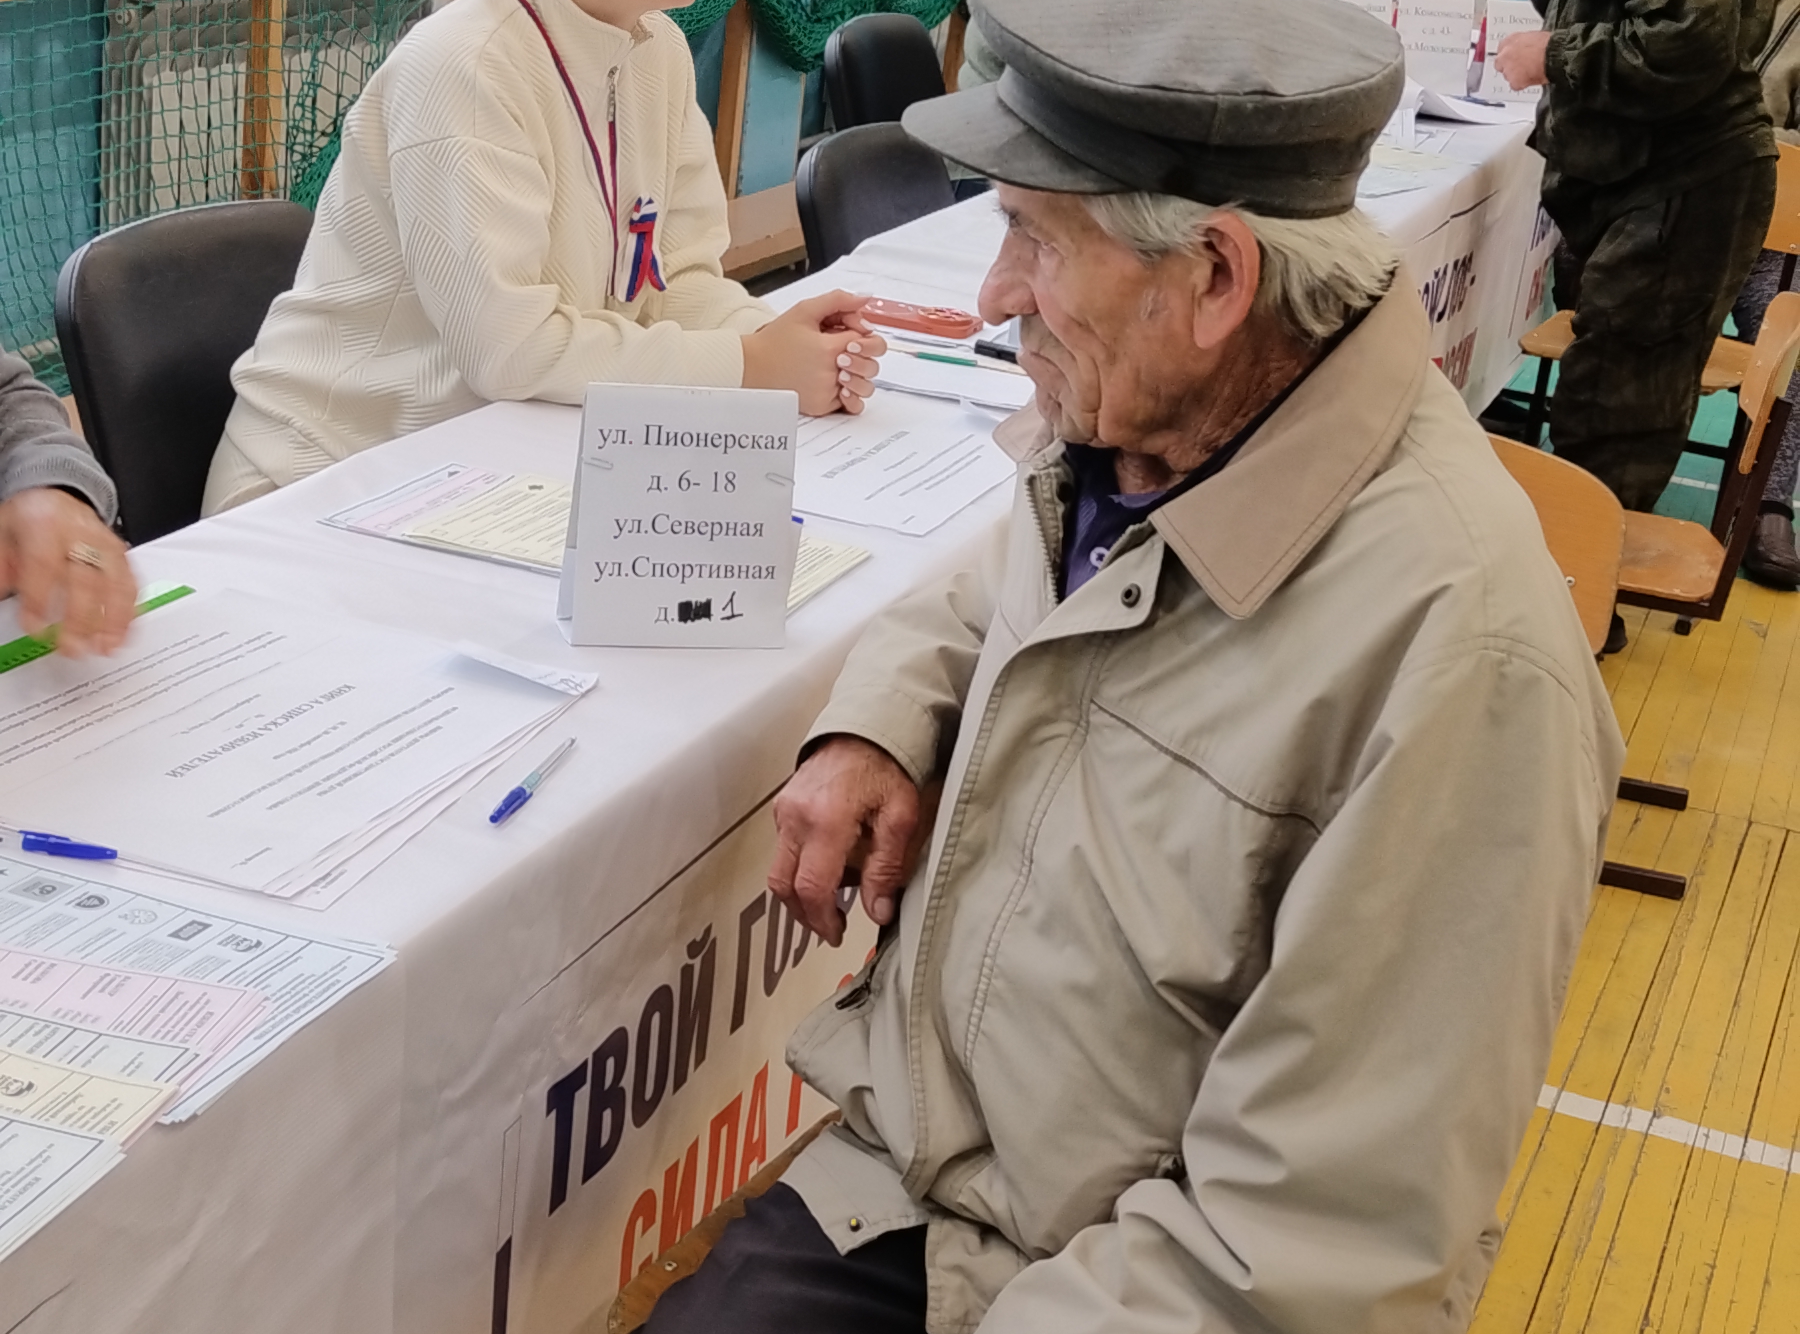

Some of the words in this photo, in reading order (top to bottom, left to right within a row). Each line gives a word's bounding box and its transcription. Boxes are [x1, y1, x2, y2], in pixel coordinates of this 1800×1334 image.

[597, 427, 634, 450] ул.
[643, 424, 789, 454] Пионерская
[647, 474, 669, 493] д.
[711, 471, 737, 493] 18
[613, 513, 764, 541] ул.Северная
[593, 556, 777, 584] ул.Спортивная
[654, 605, 675, 624] д.
[719, 591, 744, 621] 1
[545, 924, 718, 1218] ТВОЙ
[617, 1059, 769, 1289] СИЛА
